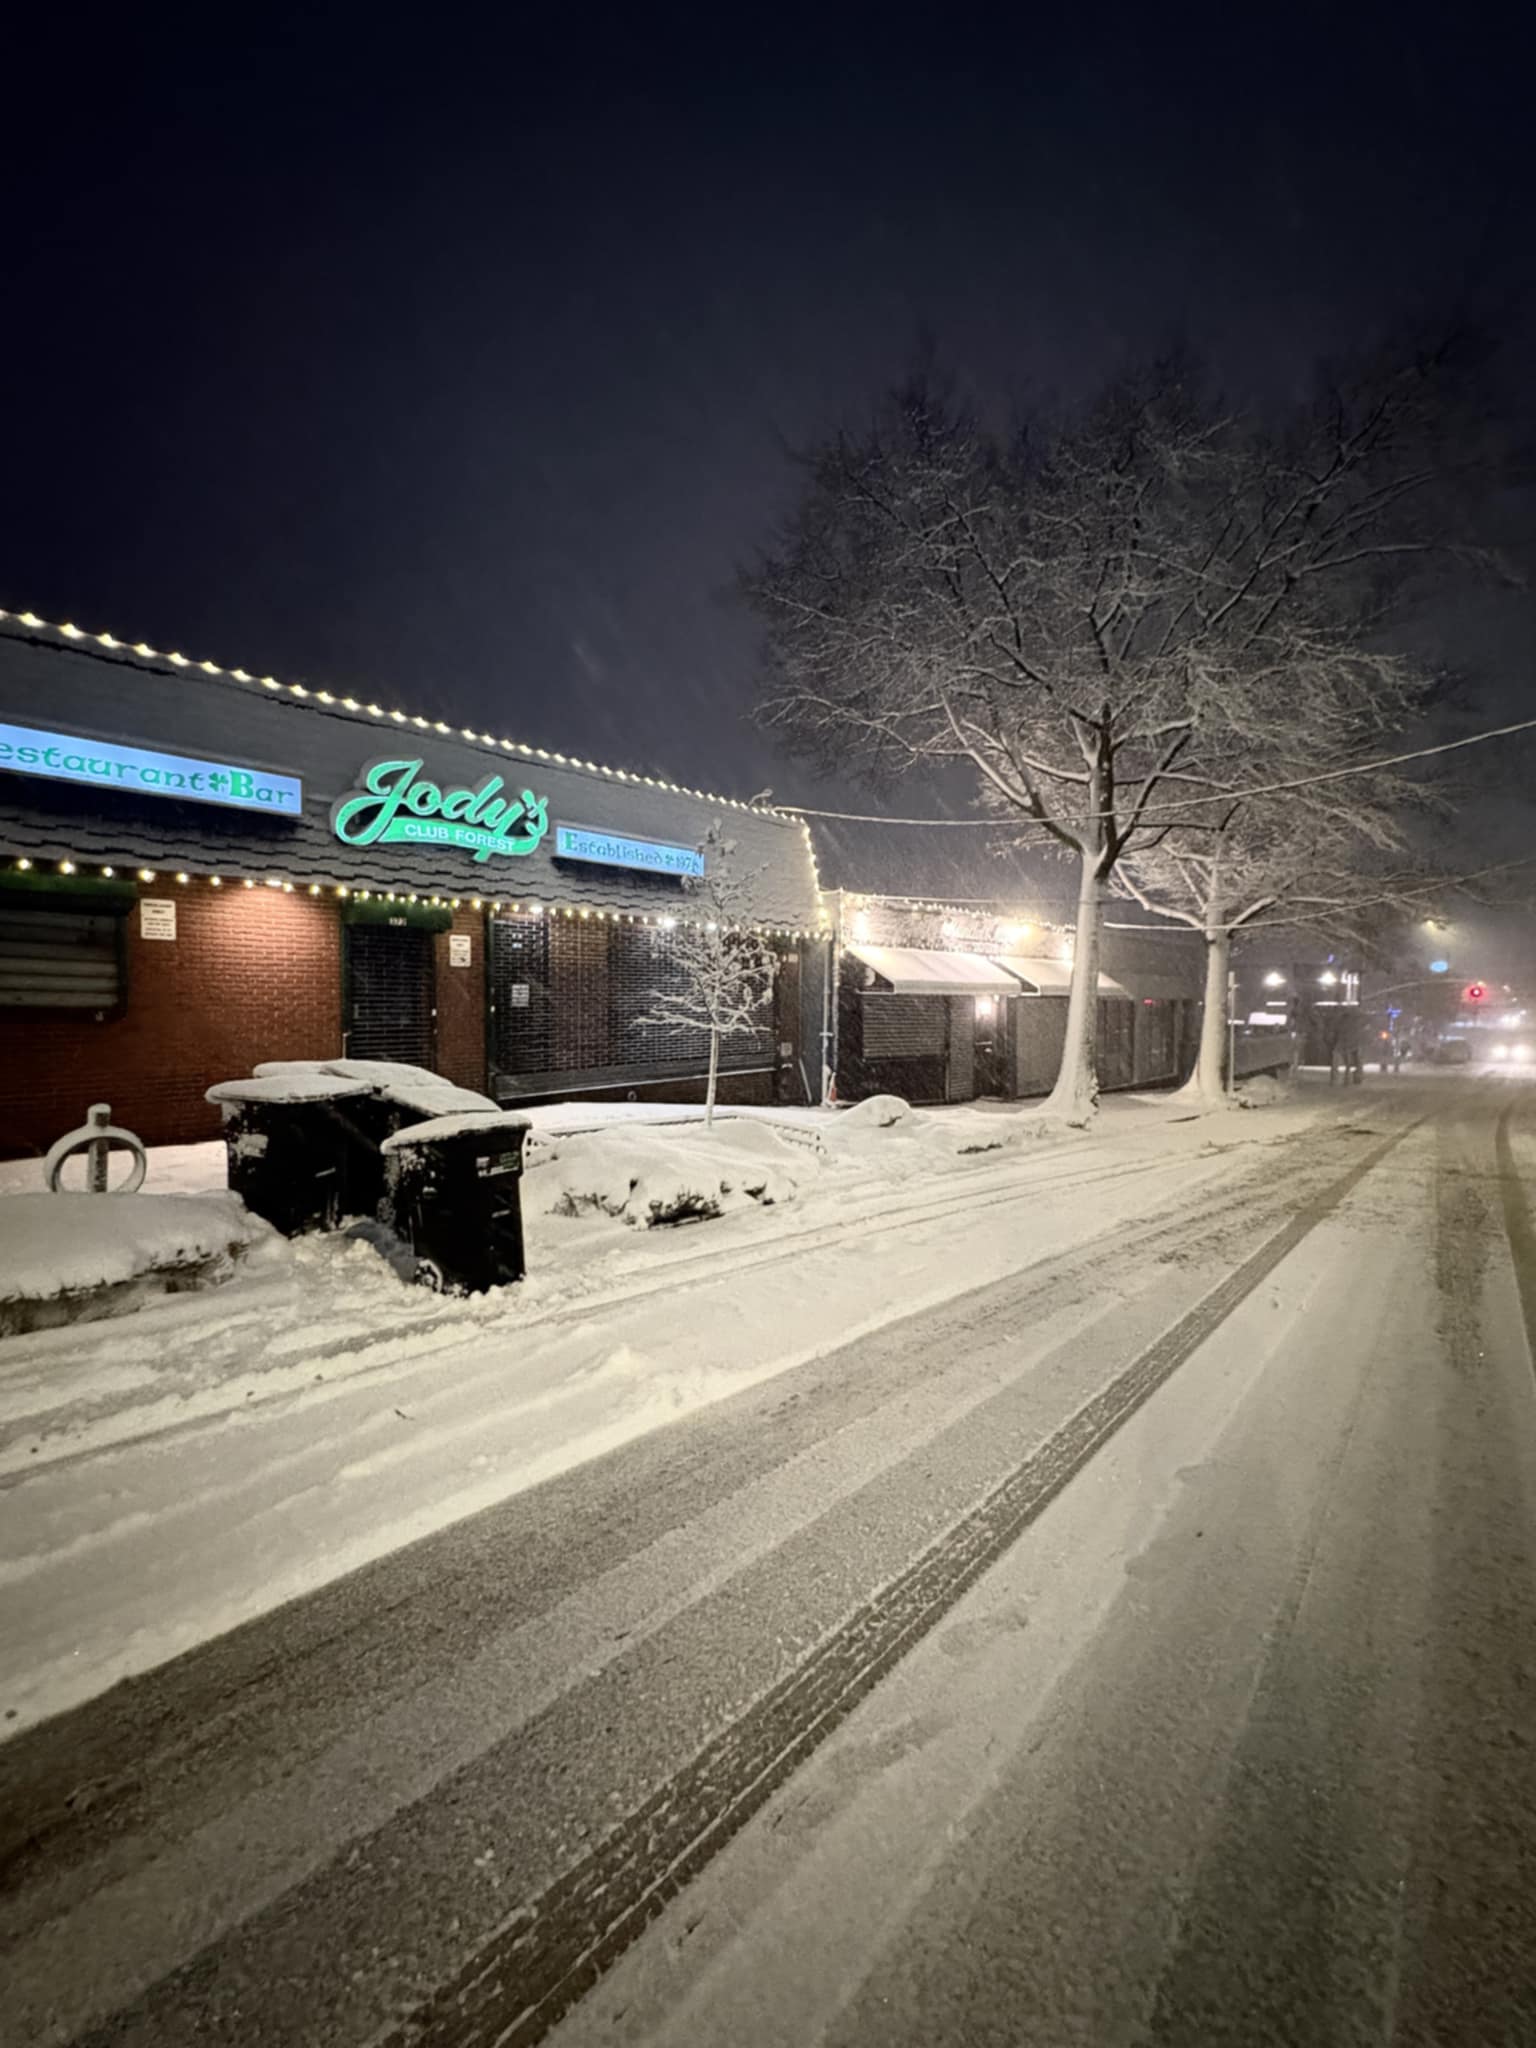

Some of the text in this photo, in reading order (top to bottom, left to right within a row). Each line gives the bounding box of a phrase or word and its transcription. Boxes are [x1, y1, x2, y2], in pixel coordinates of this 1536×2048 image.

[229, 769, 294, 804] Bar
[336, 758, 549, 863] Jody's
[404, 823, 515, 852] CLUB FOREST
[564, 831, 663, 864] Established
